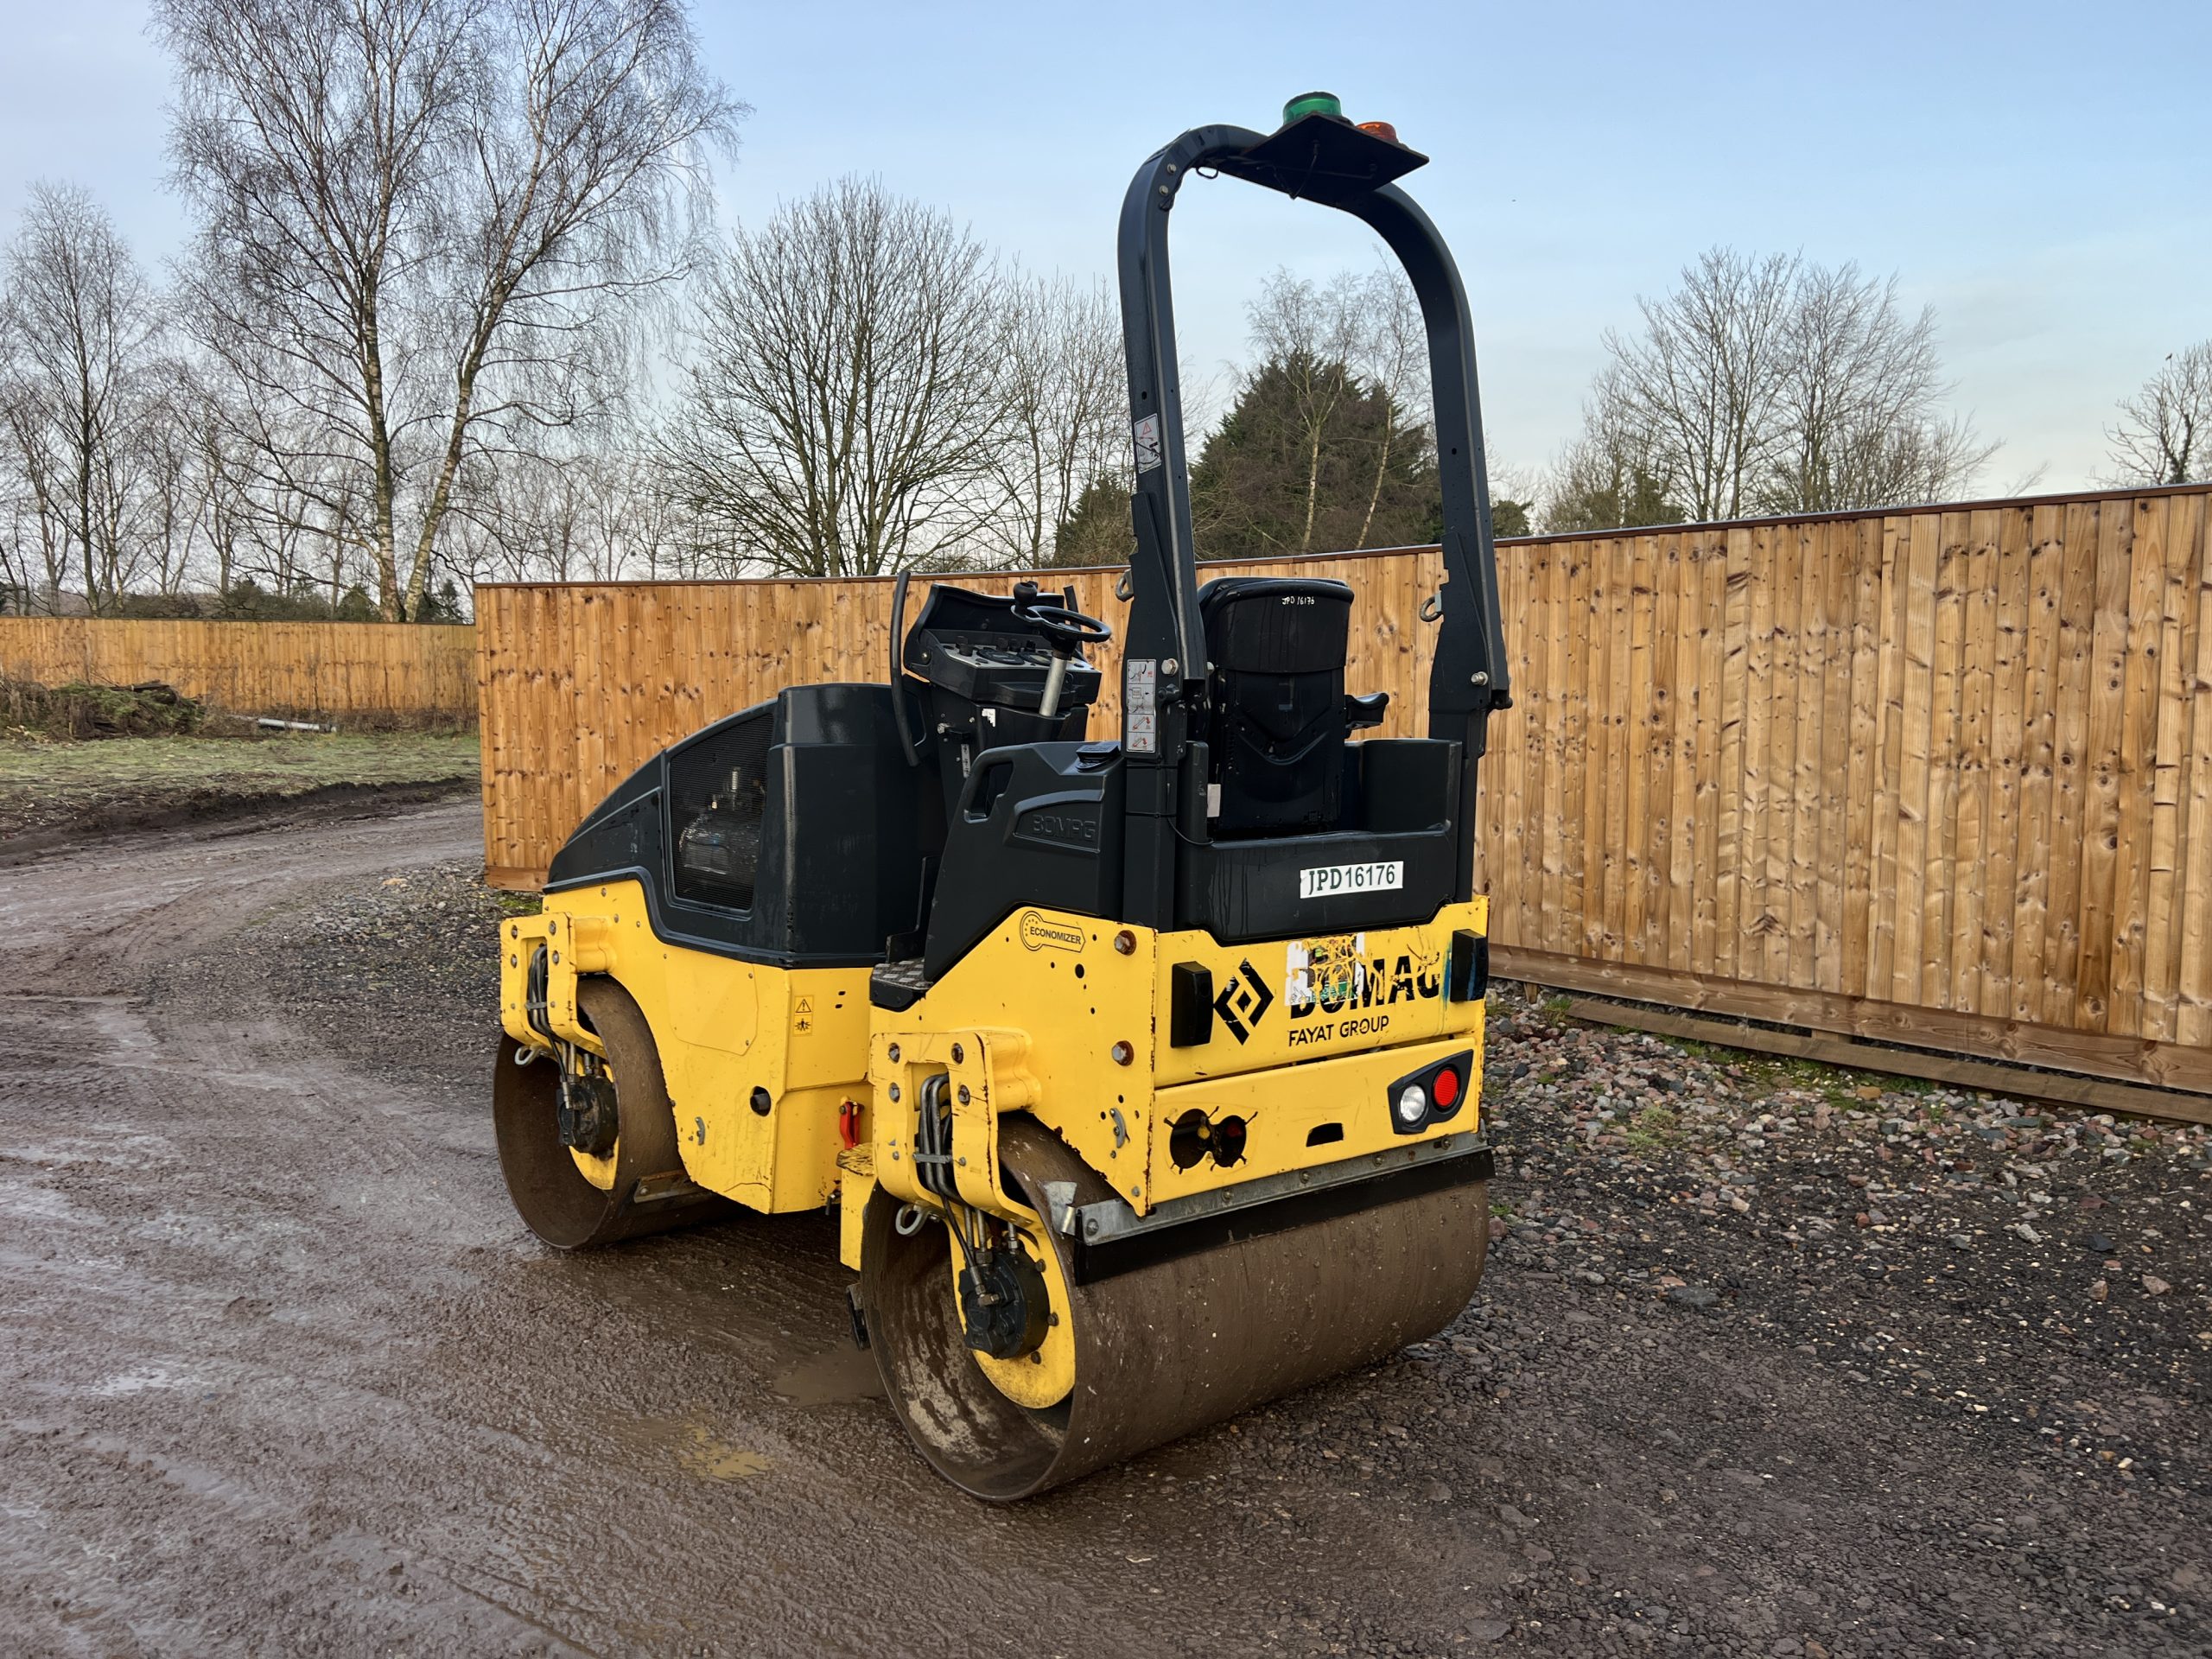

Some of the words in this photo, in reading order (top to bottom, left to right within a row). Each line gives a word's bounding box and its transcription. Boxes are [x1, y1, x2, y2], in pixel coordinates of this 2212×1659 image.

[1308, 864, 1395, 895] JPD16176
[1030, 926, 1082, 944] ECONOMIZER
[1288, 1024, 1334, 1047] FAYAT
[1339, 1015, 1389, 1038] GROUP
